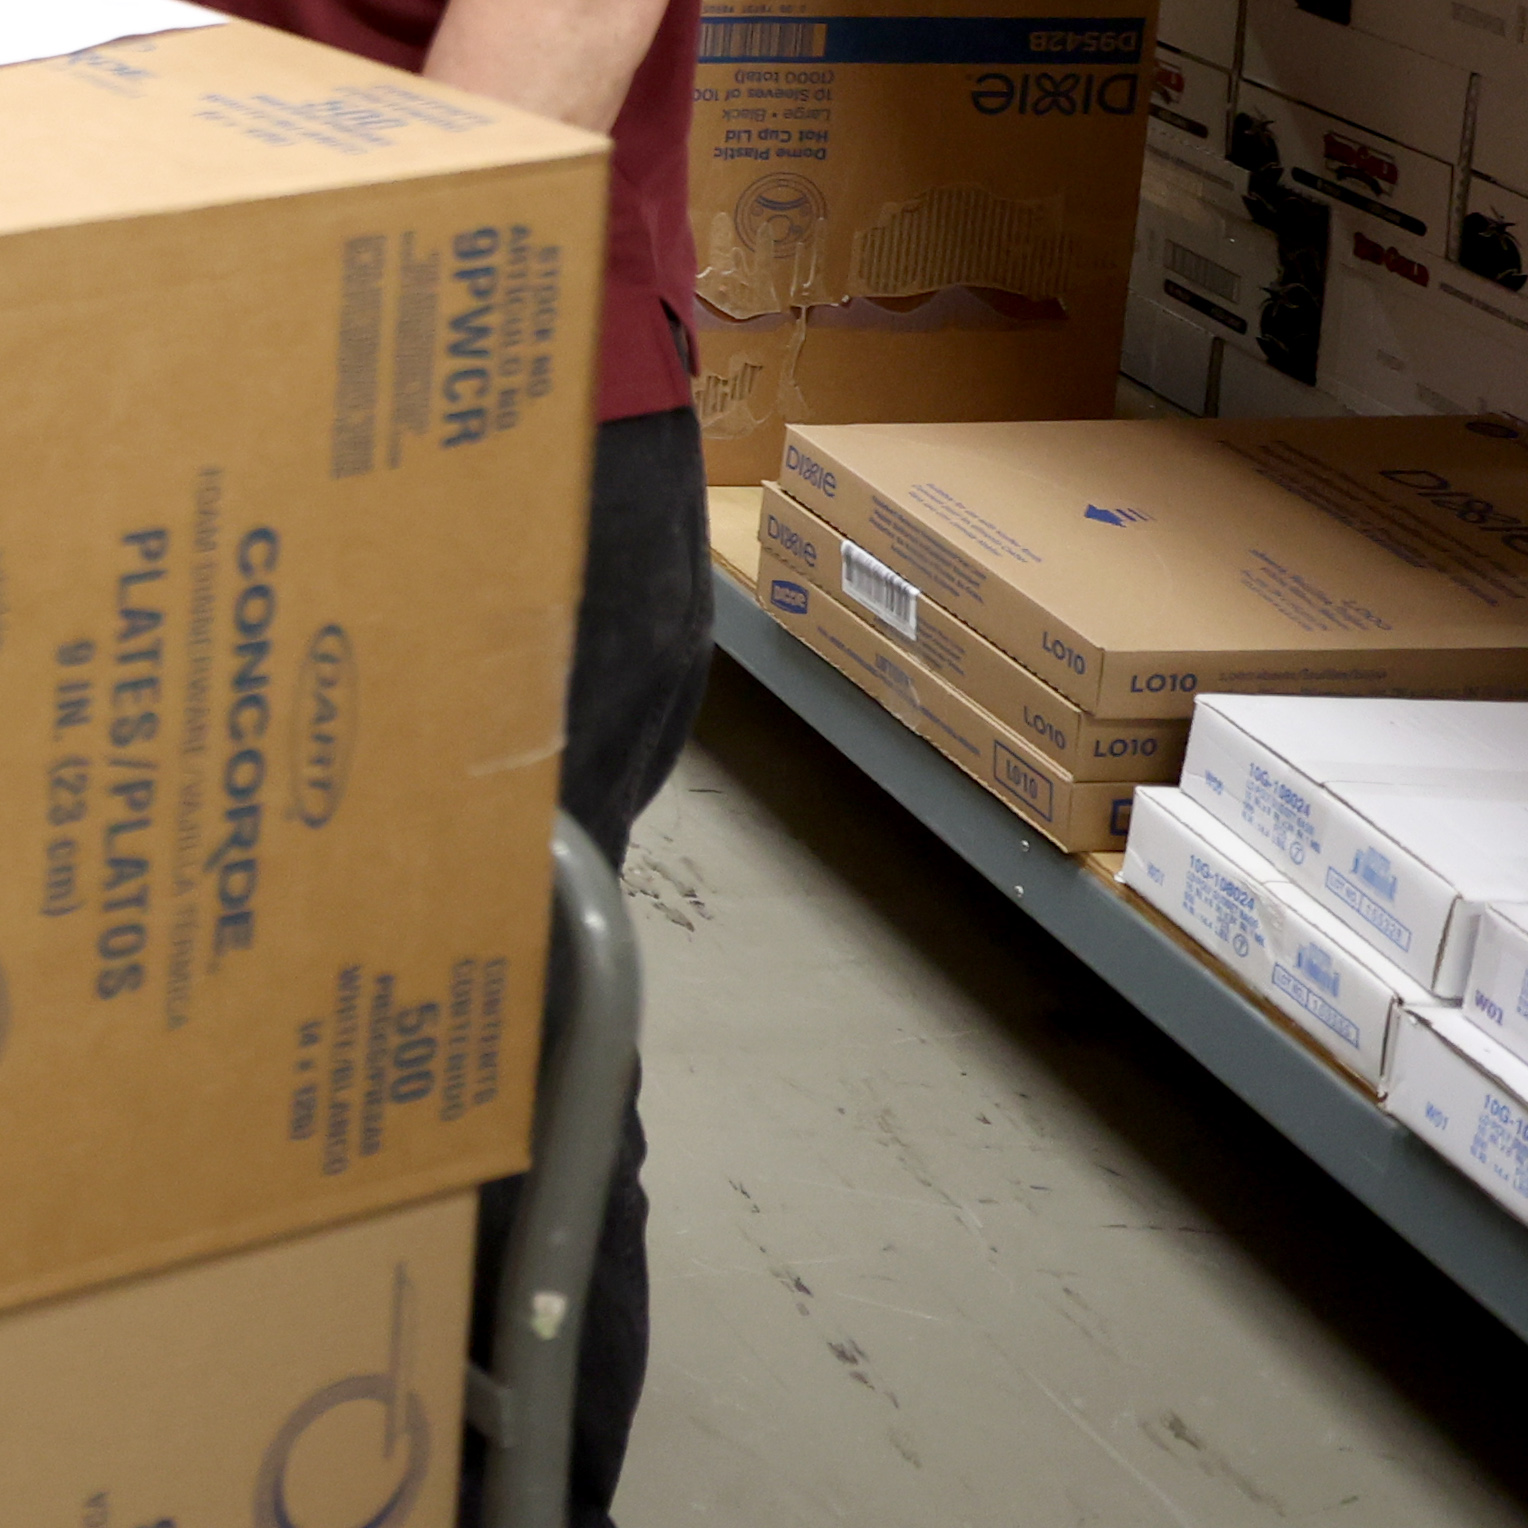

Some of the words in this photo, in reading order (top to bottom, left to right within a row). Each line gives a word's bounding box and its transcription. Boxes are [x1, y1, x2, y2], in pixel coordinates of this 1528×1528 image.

[1029, 30, 1138, 53] D9542B
[735, 70, 780, 84] total)
[720, 88, 740, 101] of
[746, 88, 808, 101] Sleeves
[815, 89, 832, 101] 10
[722, 106, 765, 121] Black
[784, 106, 830, 121] Large
[725, 129, 751, 143] Lid
[757, 129, 792, 144] Cup
[800, 129, 829, 143] Hot
[714, 146, 771, 160] Plastic
[777, 147, 826, 160] Dome
[534, 245, 562, 346] STOCK
[441, 226, 499, 449] 9PWCR
[55, 638, 95, 668] 9
[206, 523, 282, 956] CONCORDE
[96, 528, 169, 1003] PLATES/PLATOS
[45, 753, 91, 828] (23
[40, 838, 81, 919] cm)
[390, 1001, 440, 1104] 500
